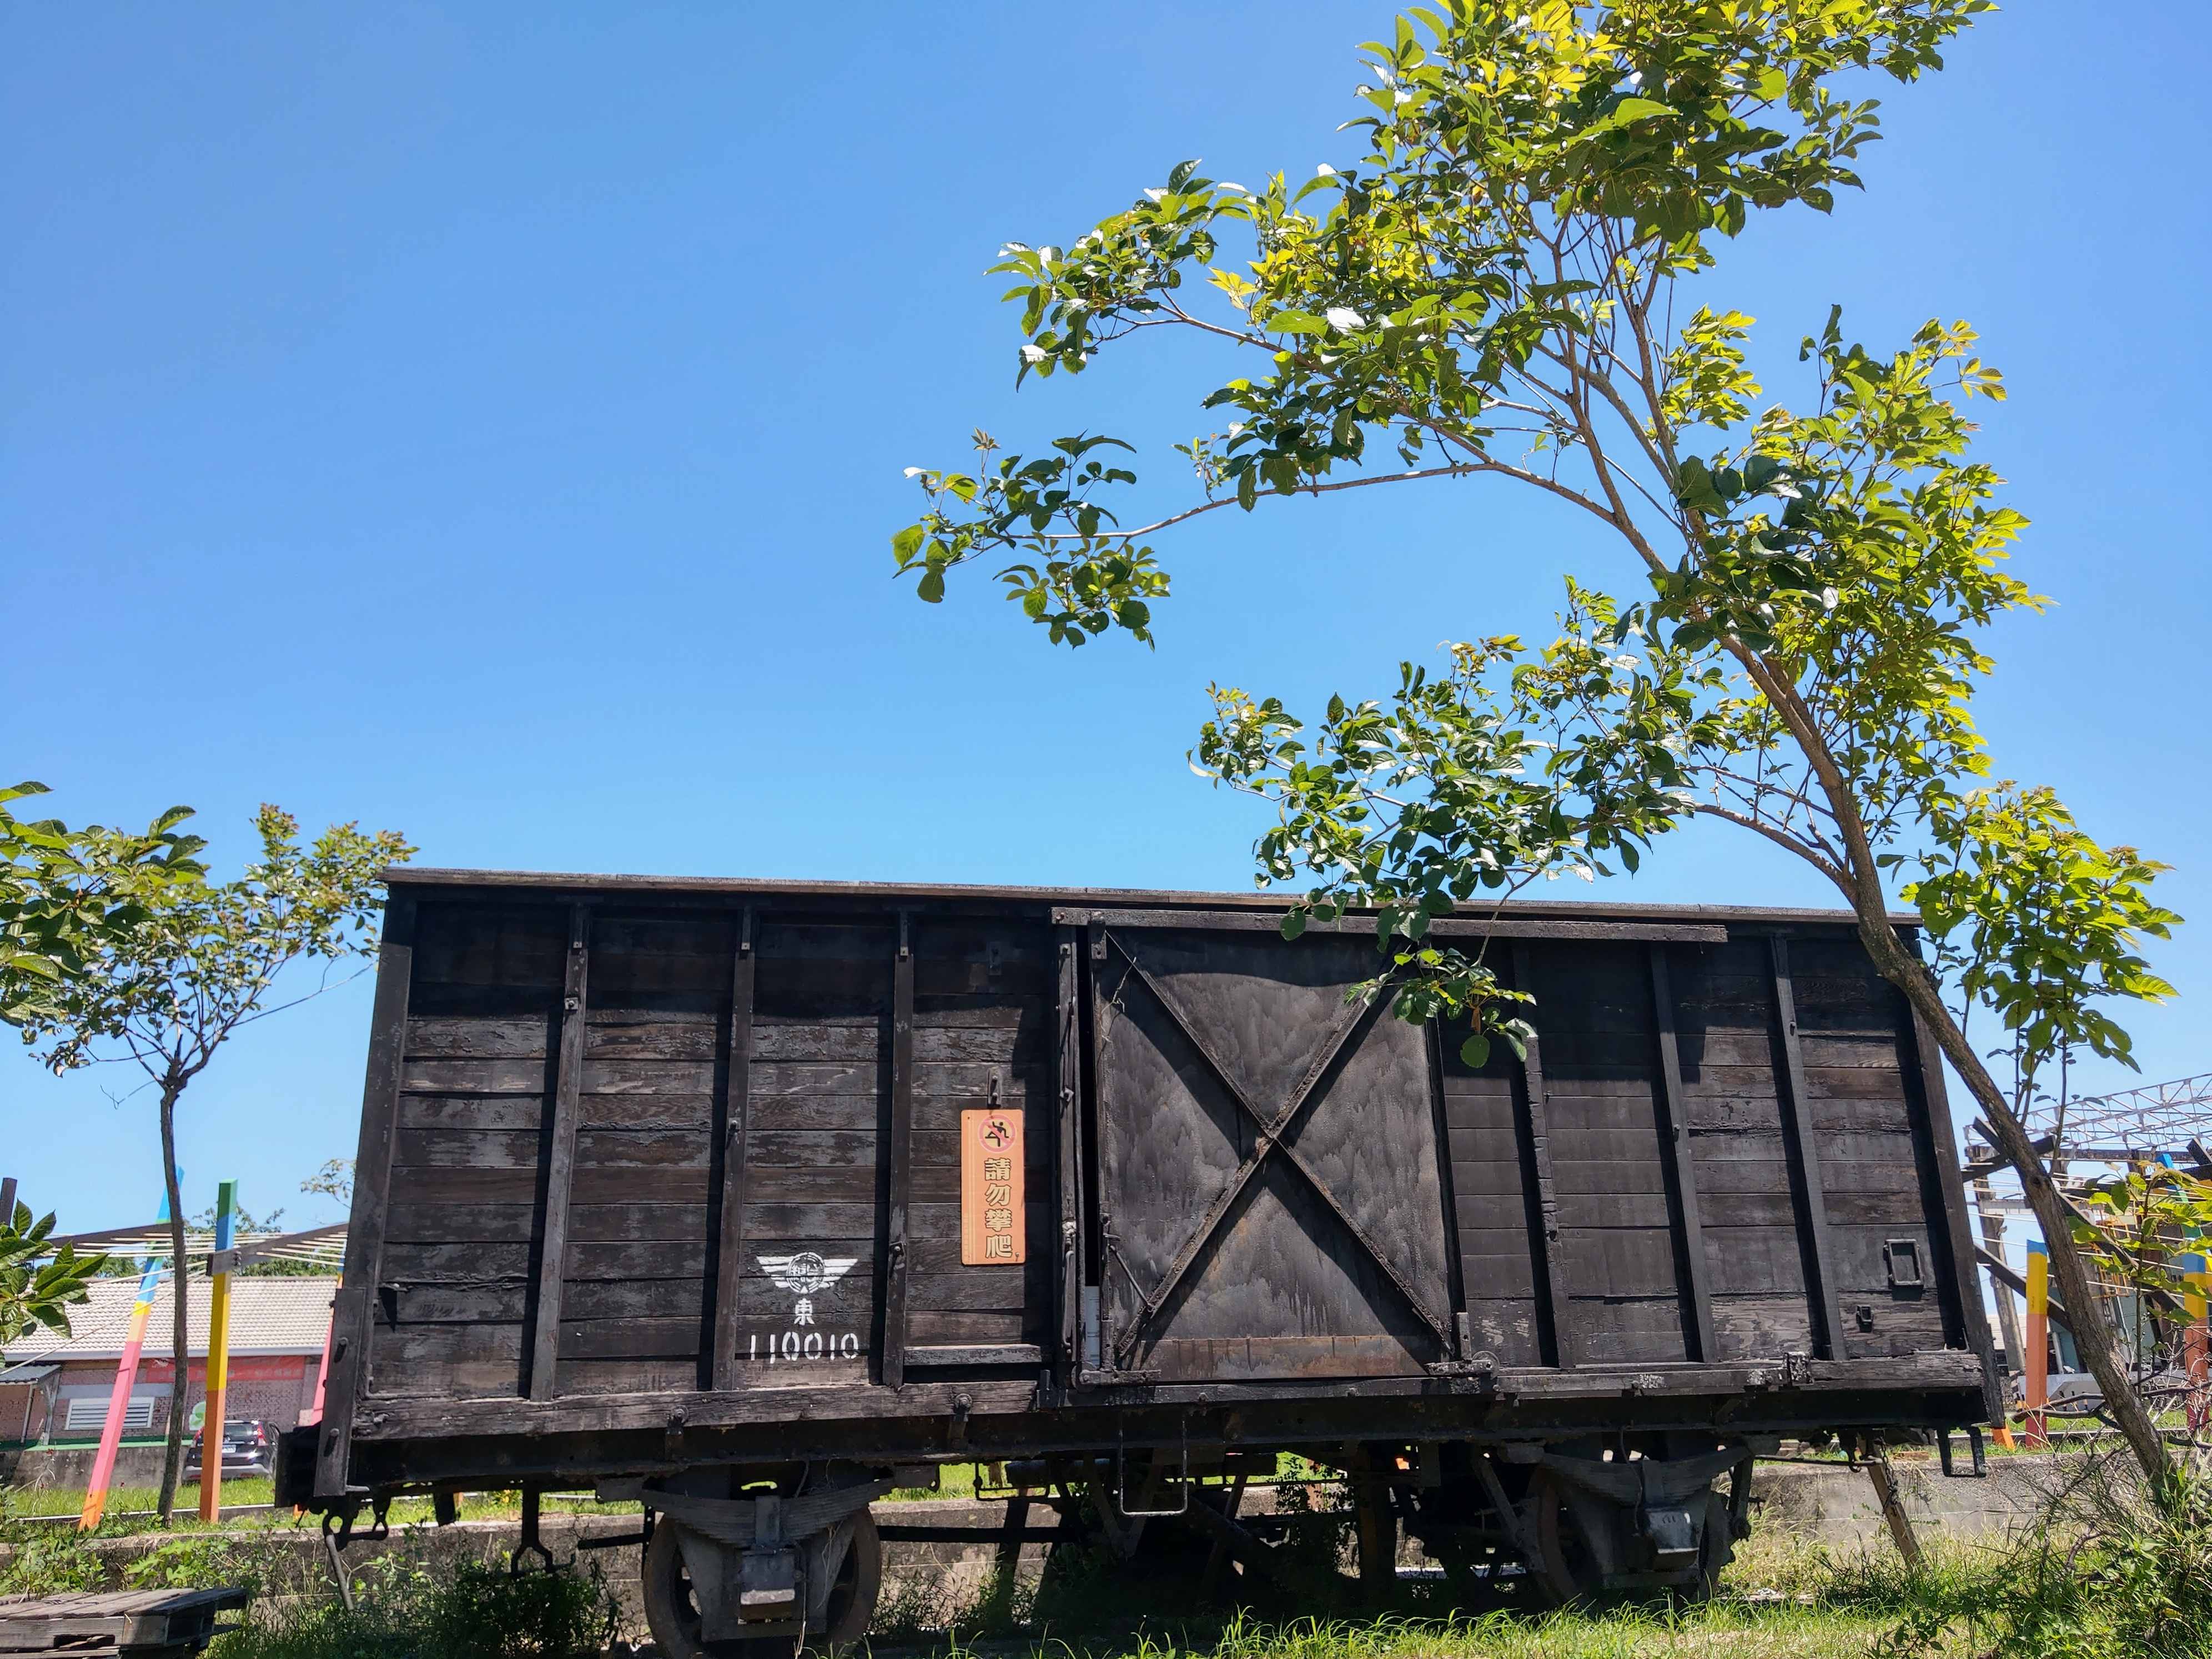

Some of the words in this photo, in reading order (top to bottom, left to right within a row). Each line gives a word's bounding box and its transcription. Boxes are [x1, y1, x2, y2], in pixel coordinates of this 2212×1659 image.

[984, 1158, 1012, 1259] 請勿攀爬
[794, 1298, 815, 1325] 東
[750, 1331, 859, 1364] 110010
